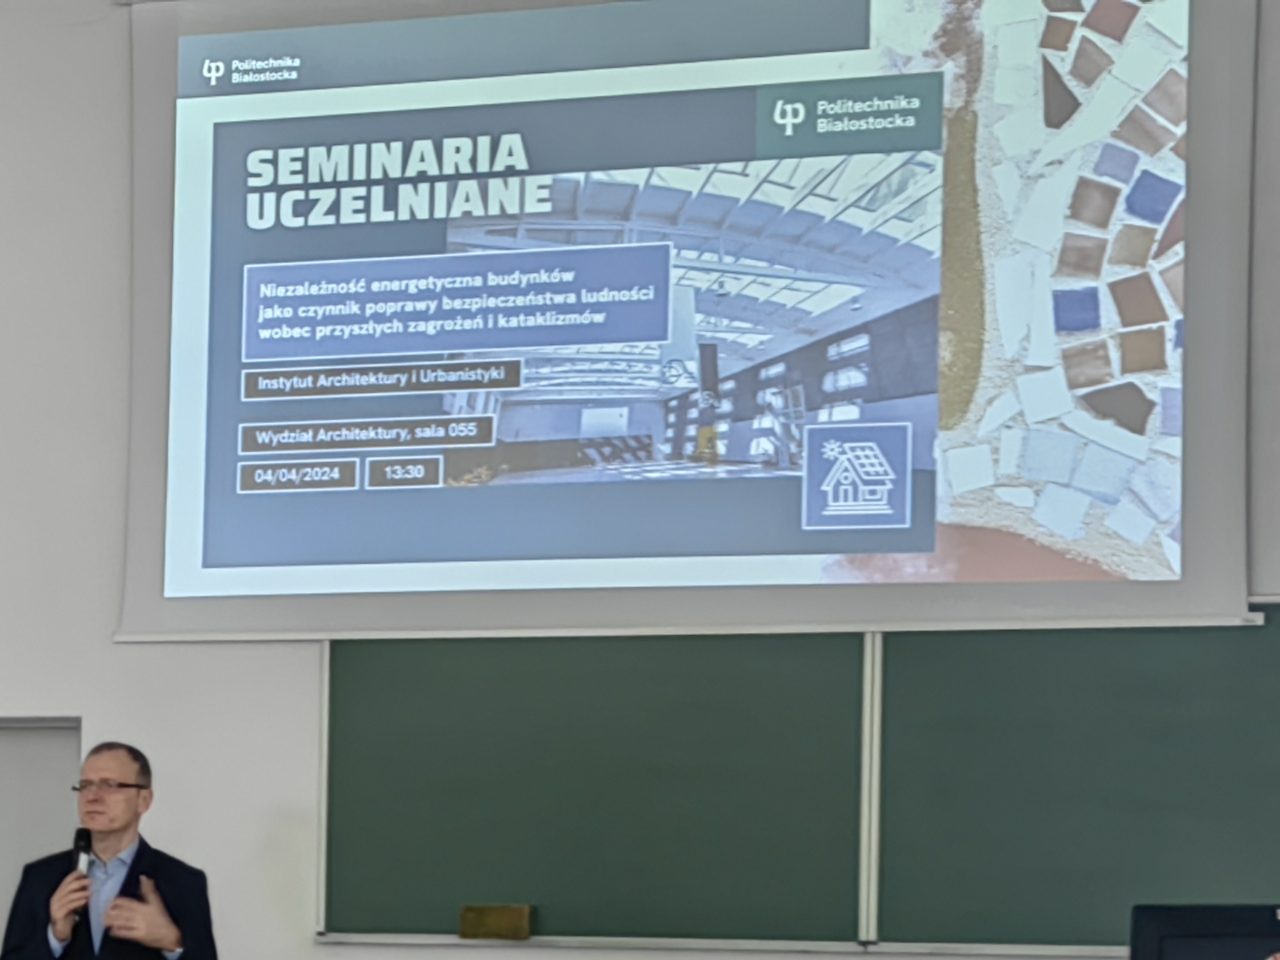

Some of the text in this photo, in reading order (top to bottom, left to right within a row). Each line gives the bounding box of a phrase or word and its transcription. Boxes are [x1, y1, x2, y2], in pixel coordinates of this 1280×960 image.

[231, 56, 300, 70] Politechnika
[817, 95, 920, 114] Politechnika
[816, 113, 916, 133] Białostocka
[245, 133, 530, 188] SEMINARIA
[245, 175, 554, 231] UCZELNIANE
[259, 268, 576, 298] Niezależność energetyczna budynków
[258, 285, 655, 323] jako czynnik poprawy bezpieczeństwa ludności
[258, 309, 607, 341] wobec przyszłych zagrożeń i kataklizmów
[258, 366, 506, 391] Instytut Architektury i Urbanistyki
[255, 421, 478, 446] Wydział Architektury, sala 055
[254, 466, 341, 484] 04/04/2024
[384, 464, 425, 480] 13:30
